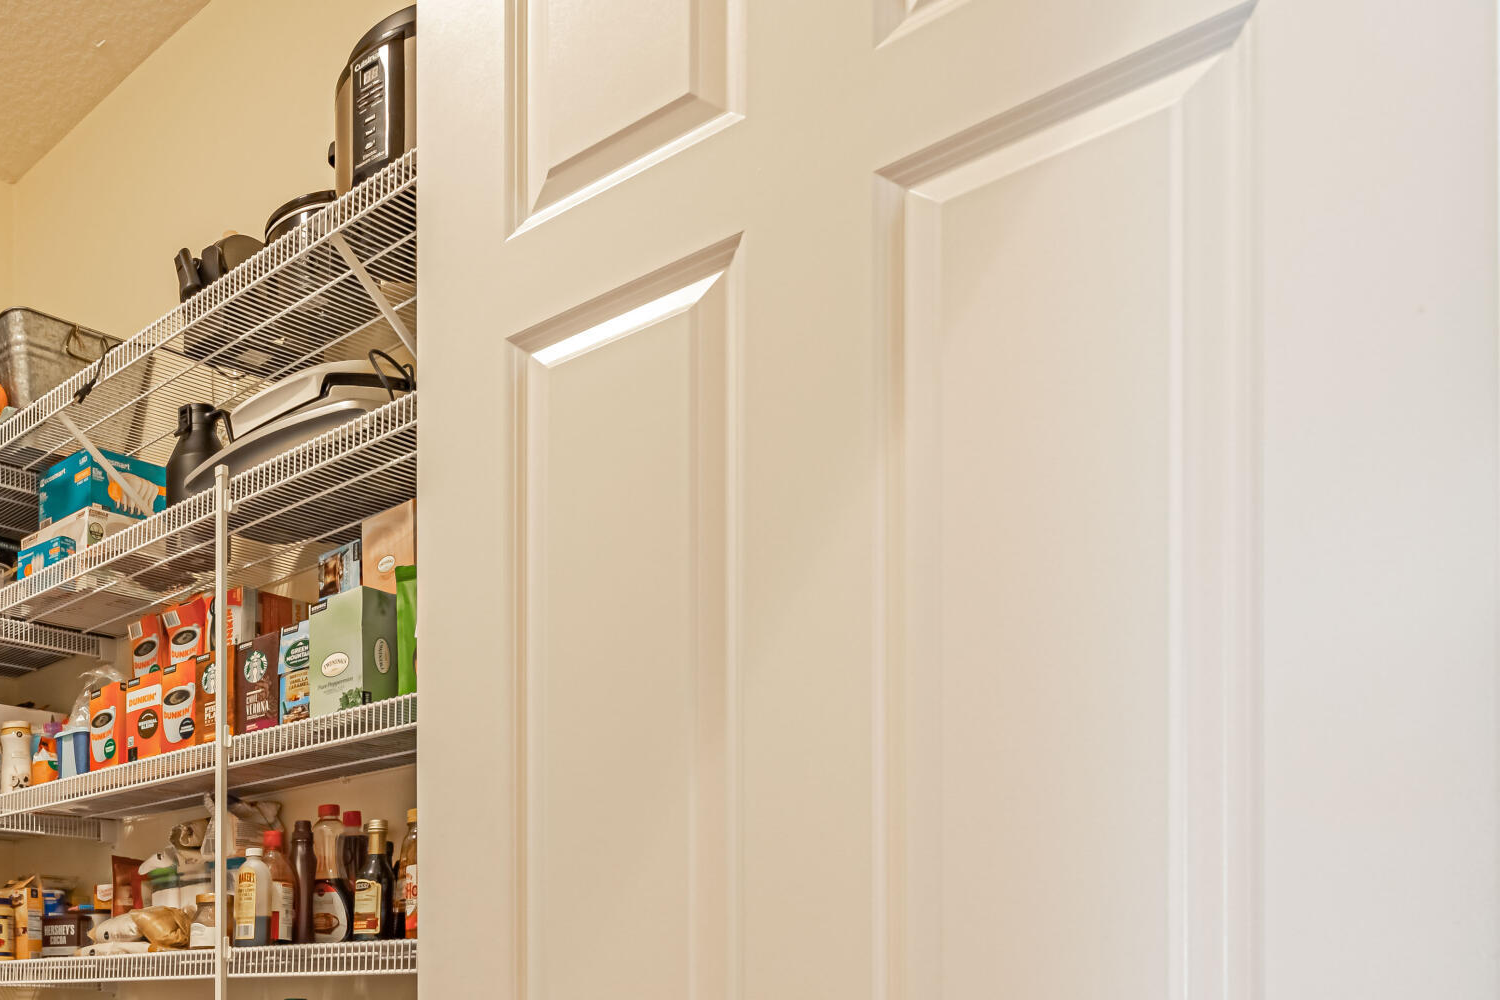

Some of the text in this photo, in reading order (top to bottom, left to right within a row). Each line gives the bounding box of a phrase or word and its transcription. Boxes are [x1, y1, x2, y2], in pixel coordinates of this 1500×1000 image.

[291, 645, 309, 655] GREEN
[44, 924, 75, 936] HERSHEY'S
[50, 936, 67, 945] COCOA
